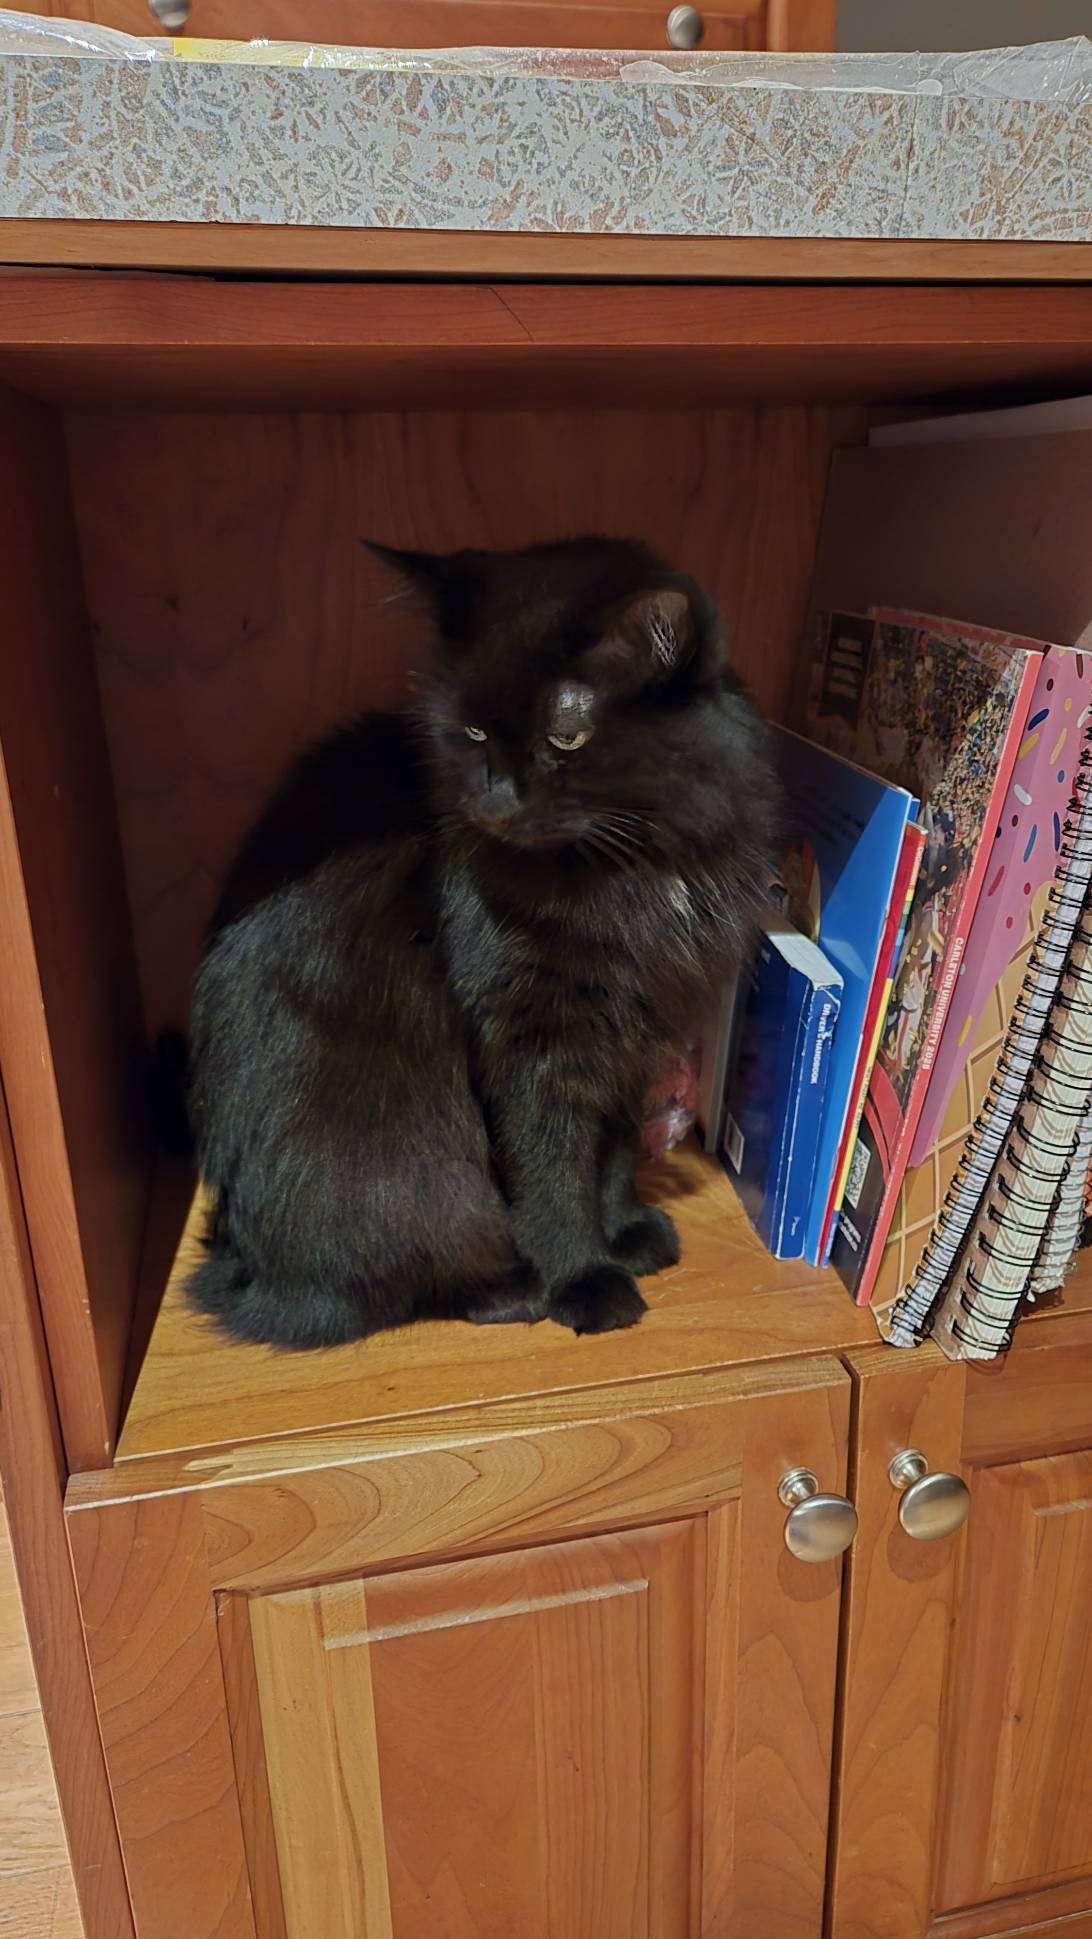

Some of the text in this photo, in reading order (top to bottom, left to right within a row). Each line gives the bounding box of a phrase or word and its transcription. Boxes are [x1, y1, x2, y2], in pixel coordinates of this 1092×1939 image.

[943, 937, 964, 988] CARLETON
[927, 989, 951, 1045] UNIVERSITY
[810, 1040, 823, 1084] HANDBOOK
